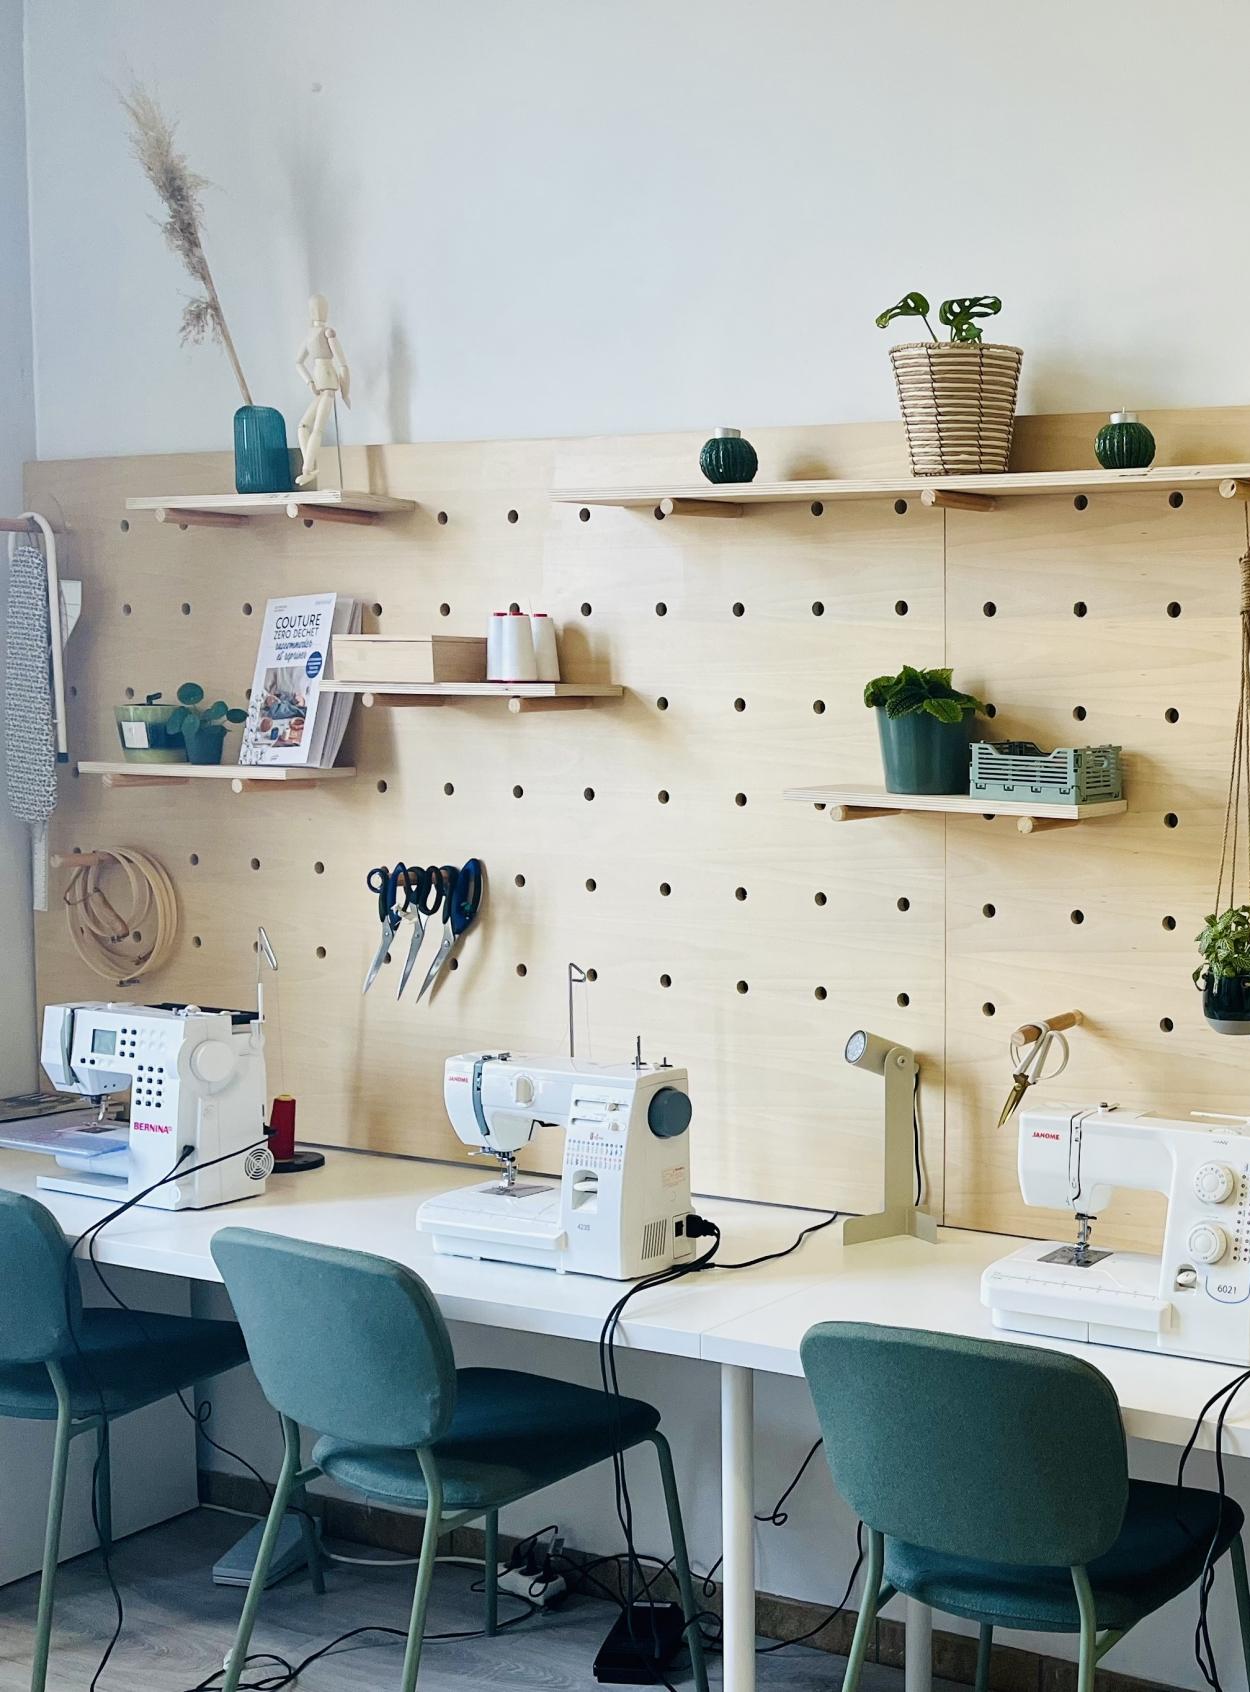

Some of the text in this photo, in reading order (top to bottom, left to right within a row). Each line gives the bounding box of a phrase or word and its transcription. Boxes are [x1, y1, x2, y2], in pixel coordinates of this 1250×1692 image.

[275, 613, 322, 629] COUTURE
[133, 1121, 169, 1134] BERNINA
[1032, 1131, 1060, 1141] JANOME
[1217, 1284, 1237, 1295] 6021
